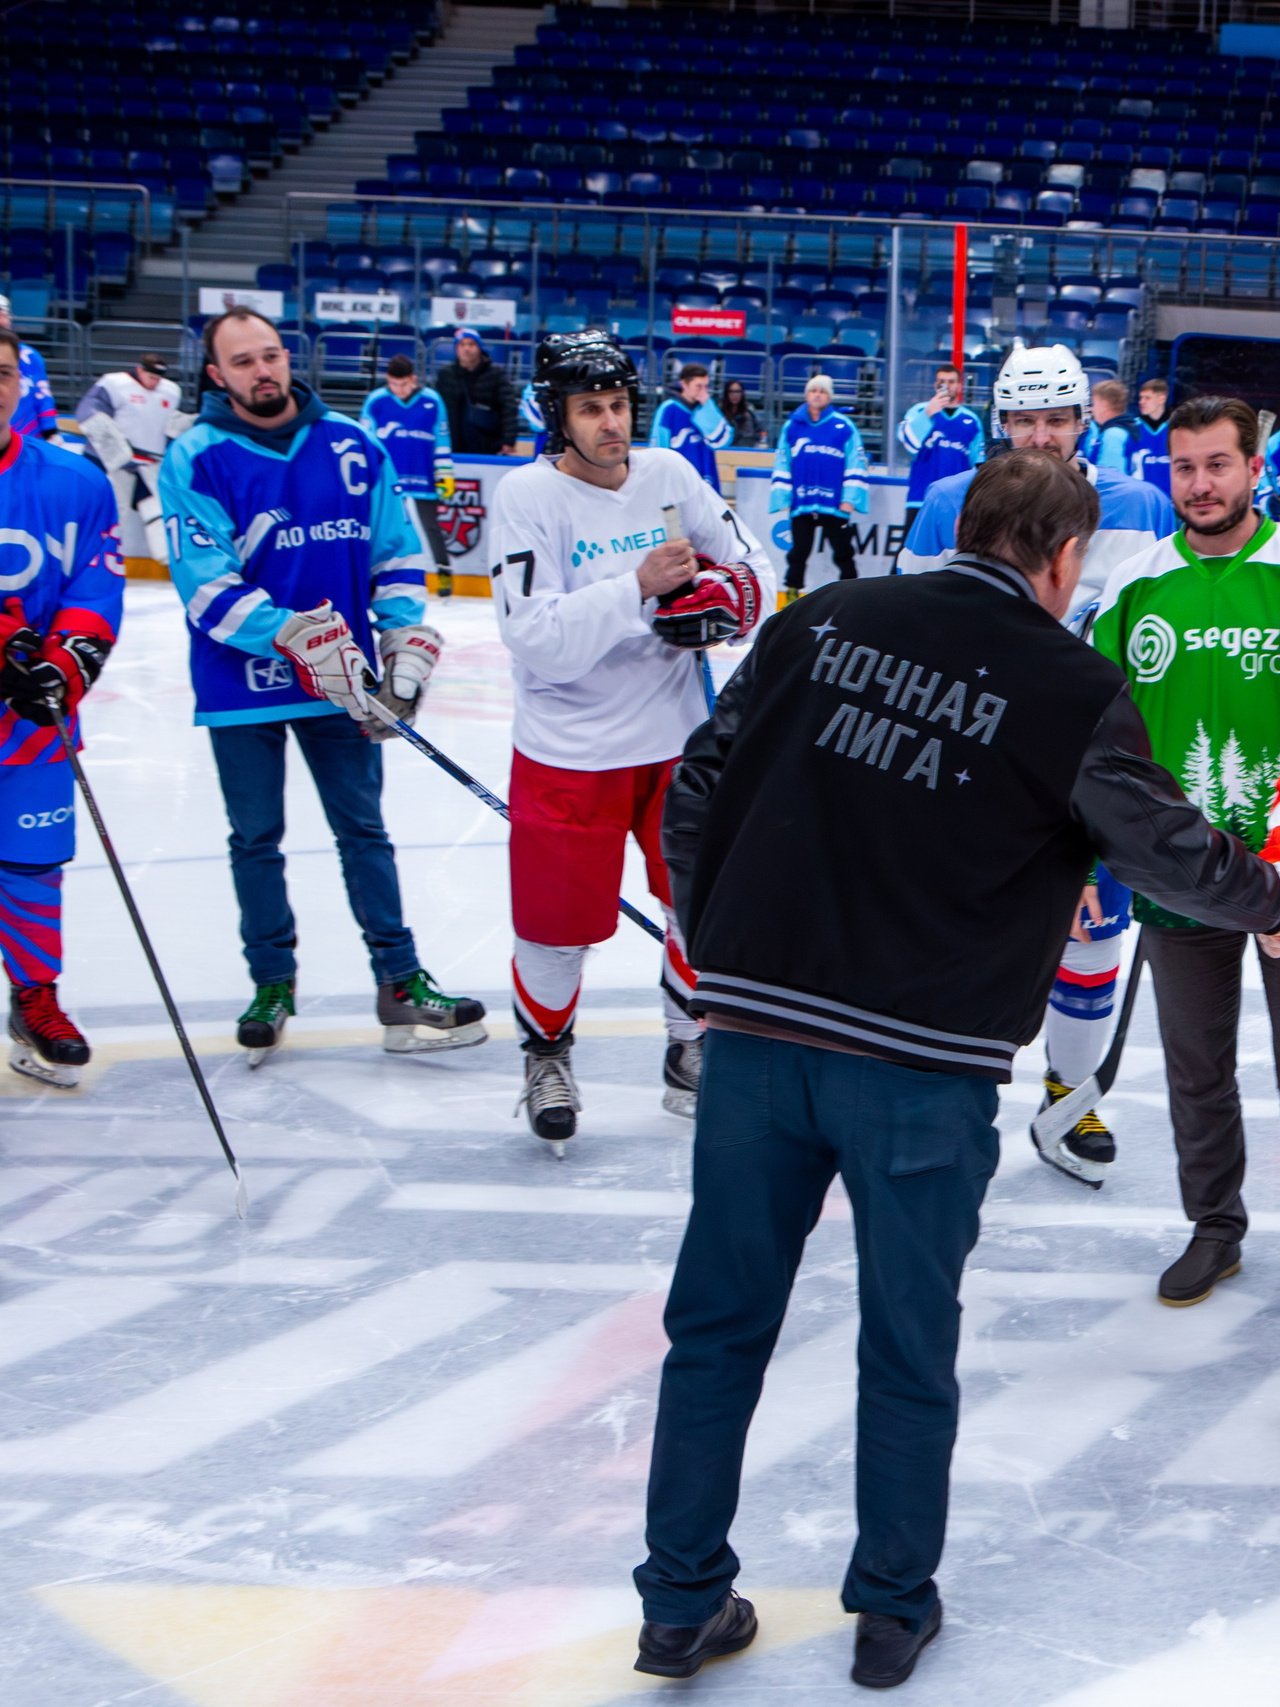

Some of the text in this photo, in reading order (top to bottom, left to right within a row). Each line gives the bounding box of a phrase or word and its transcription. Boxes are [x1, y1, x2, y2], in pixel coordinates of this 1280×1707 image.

[1018, 383, 1049, 392] CCM
[340, 451, 368, 496] C
[810, 637, 1008, 746] НОЧНАЯ
[814, 702, 943, 791] ЛИГА
[18, 806, 74, 829] OZO
